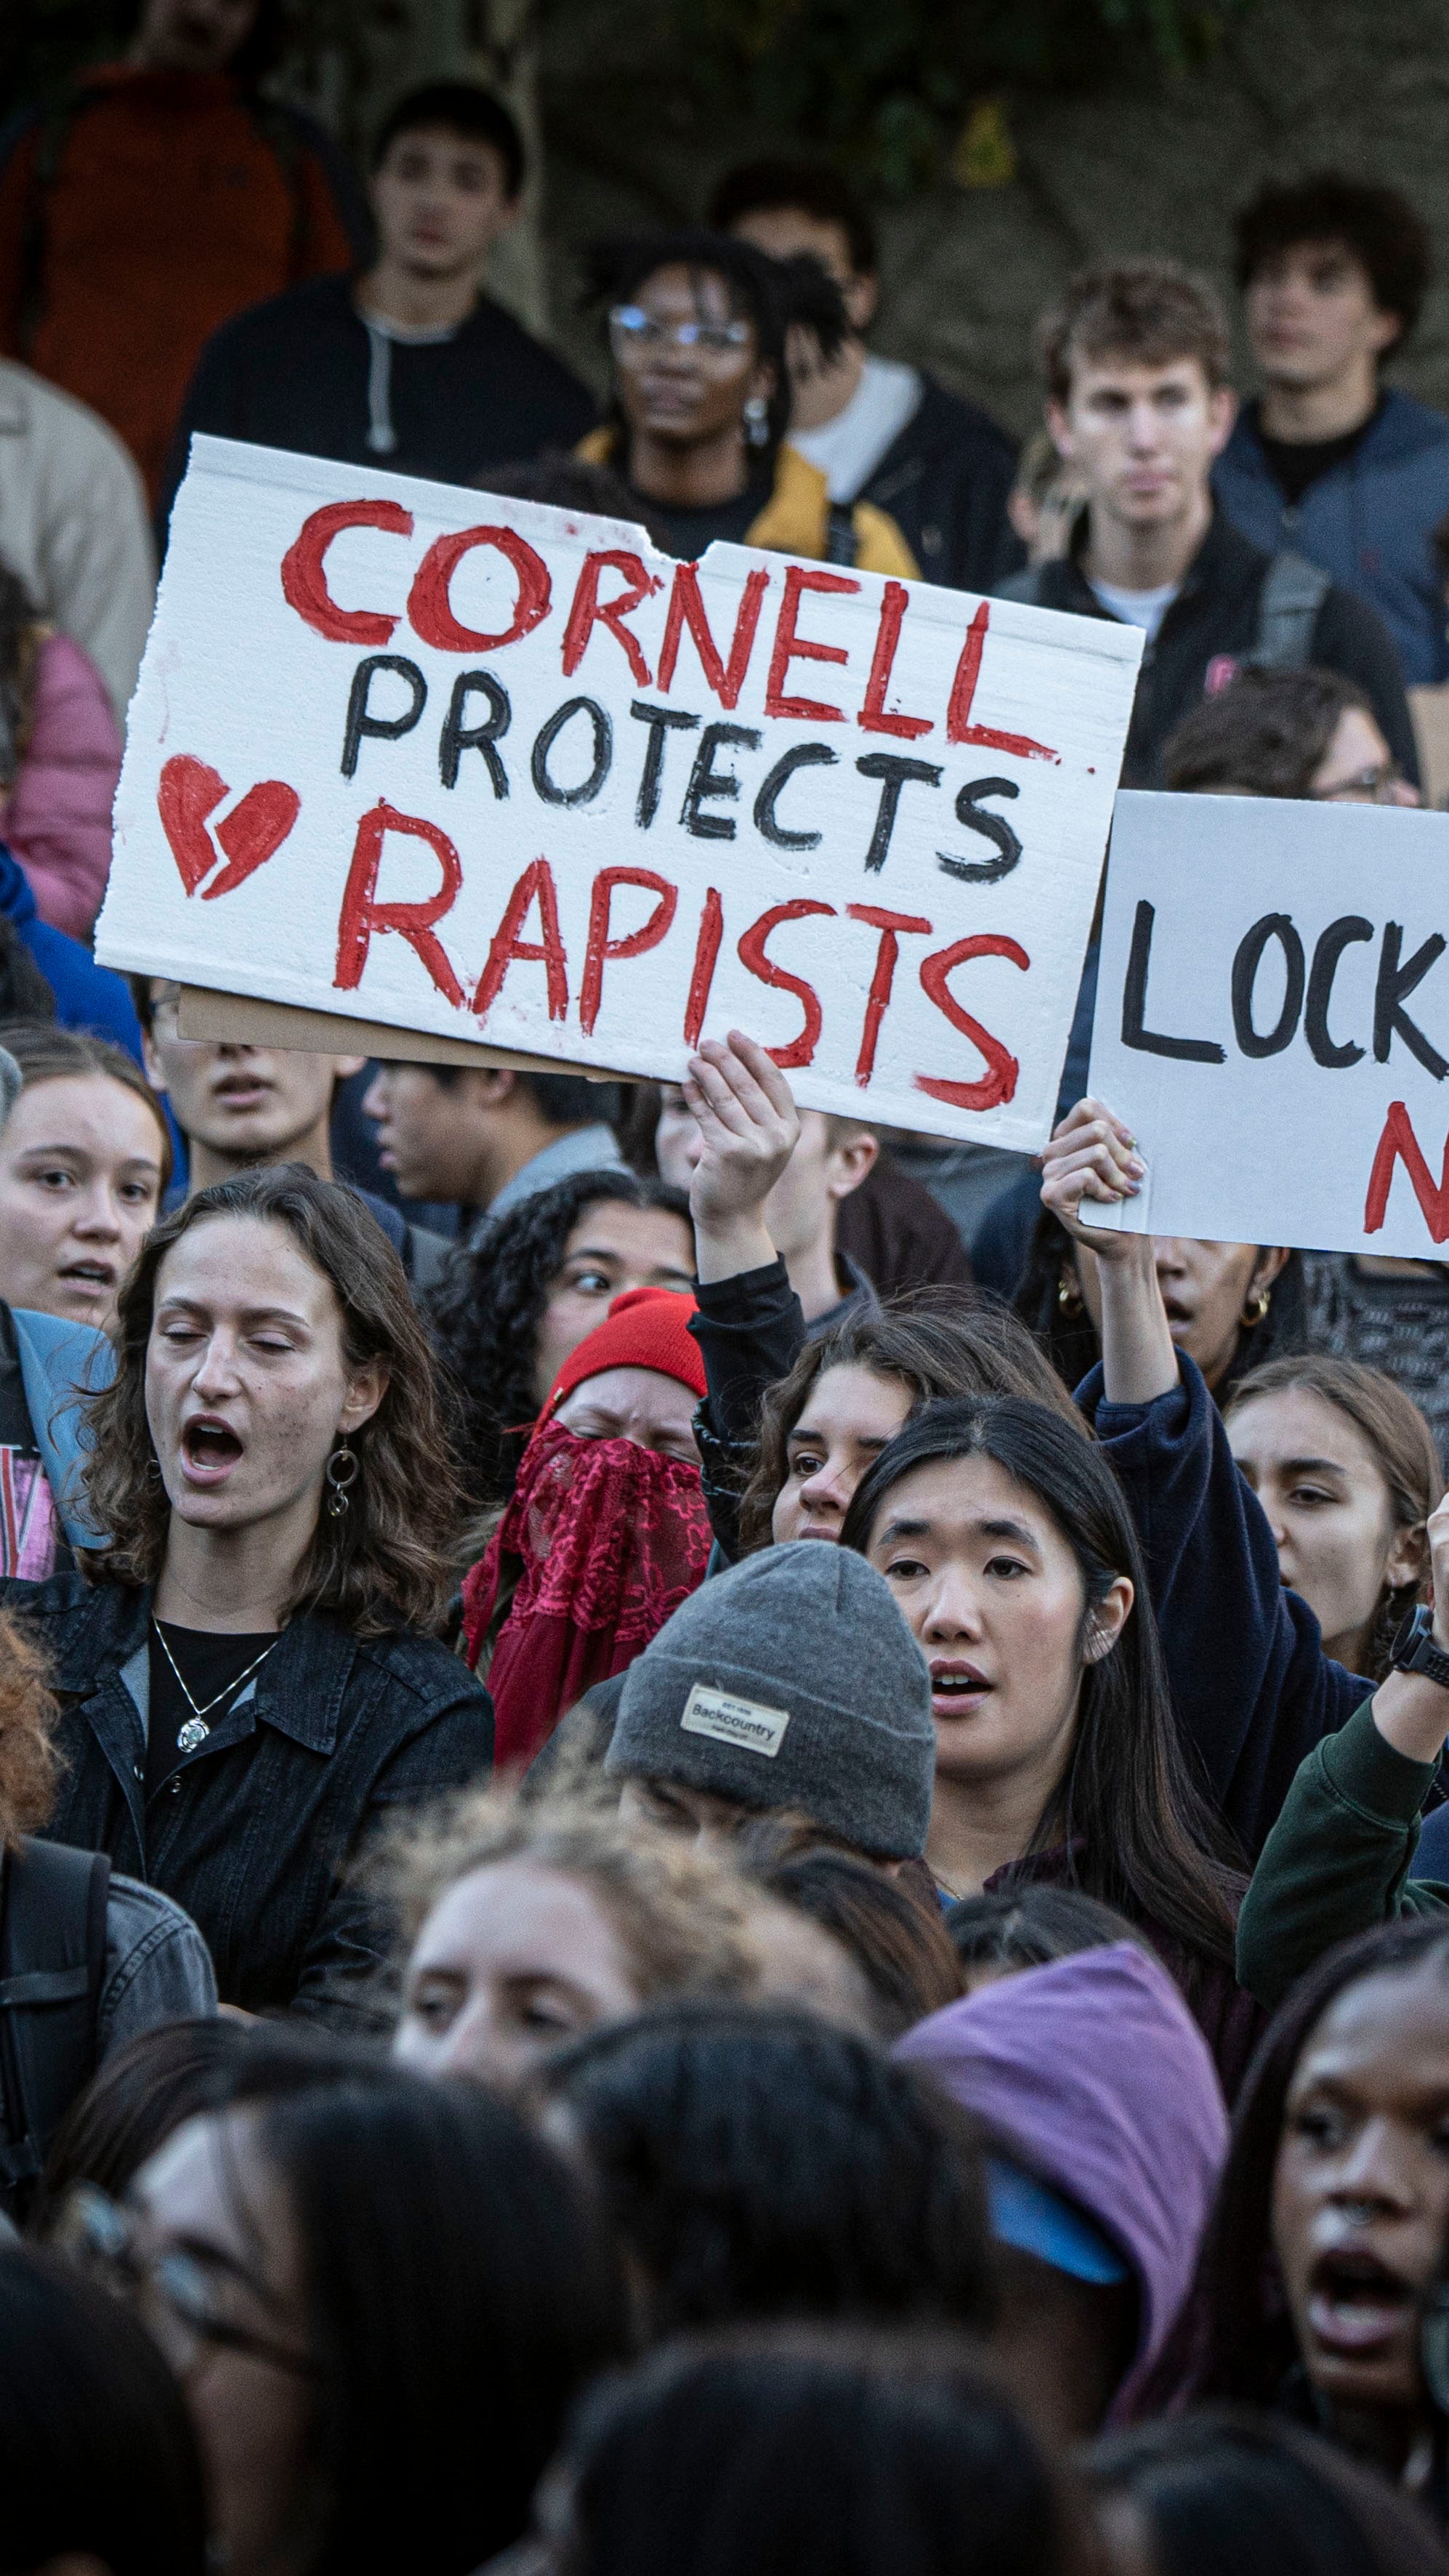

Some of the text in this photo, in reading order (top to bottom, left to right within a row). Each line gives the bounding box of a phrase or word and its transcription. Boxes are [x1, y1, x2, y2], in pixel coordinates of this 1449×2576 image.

[282, 500, 1057, 759] CORNELL
[341, 655, 1022, 882] PROTECTS
[334, 798, 1029, 1110] RAPISTS
[1121, 900, 1448, 1083] LOCK
[692, 1704, 775, 1740] Backcountry
